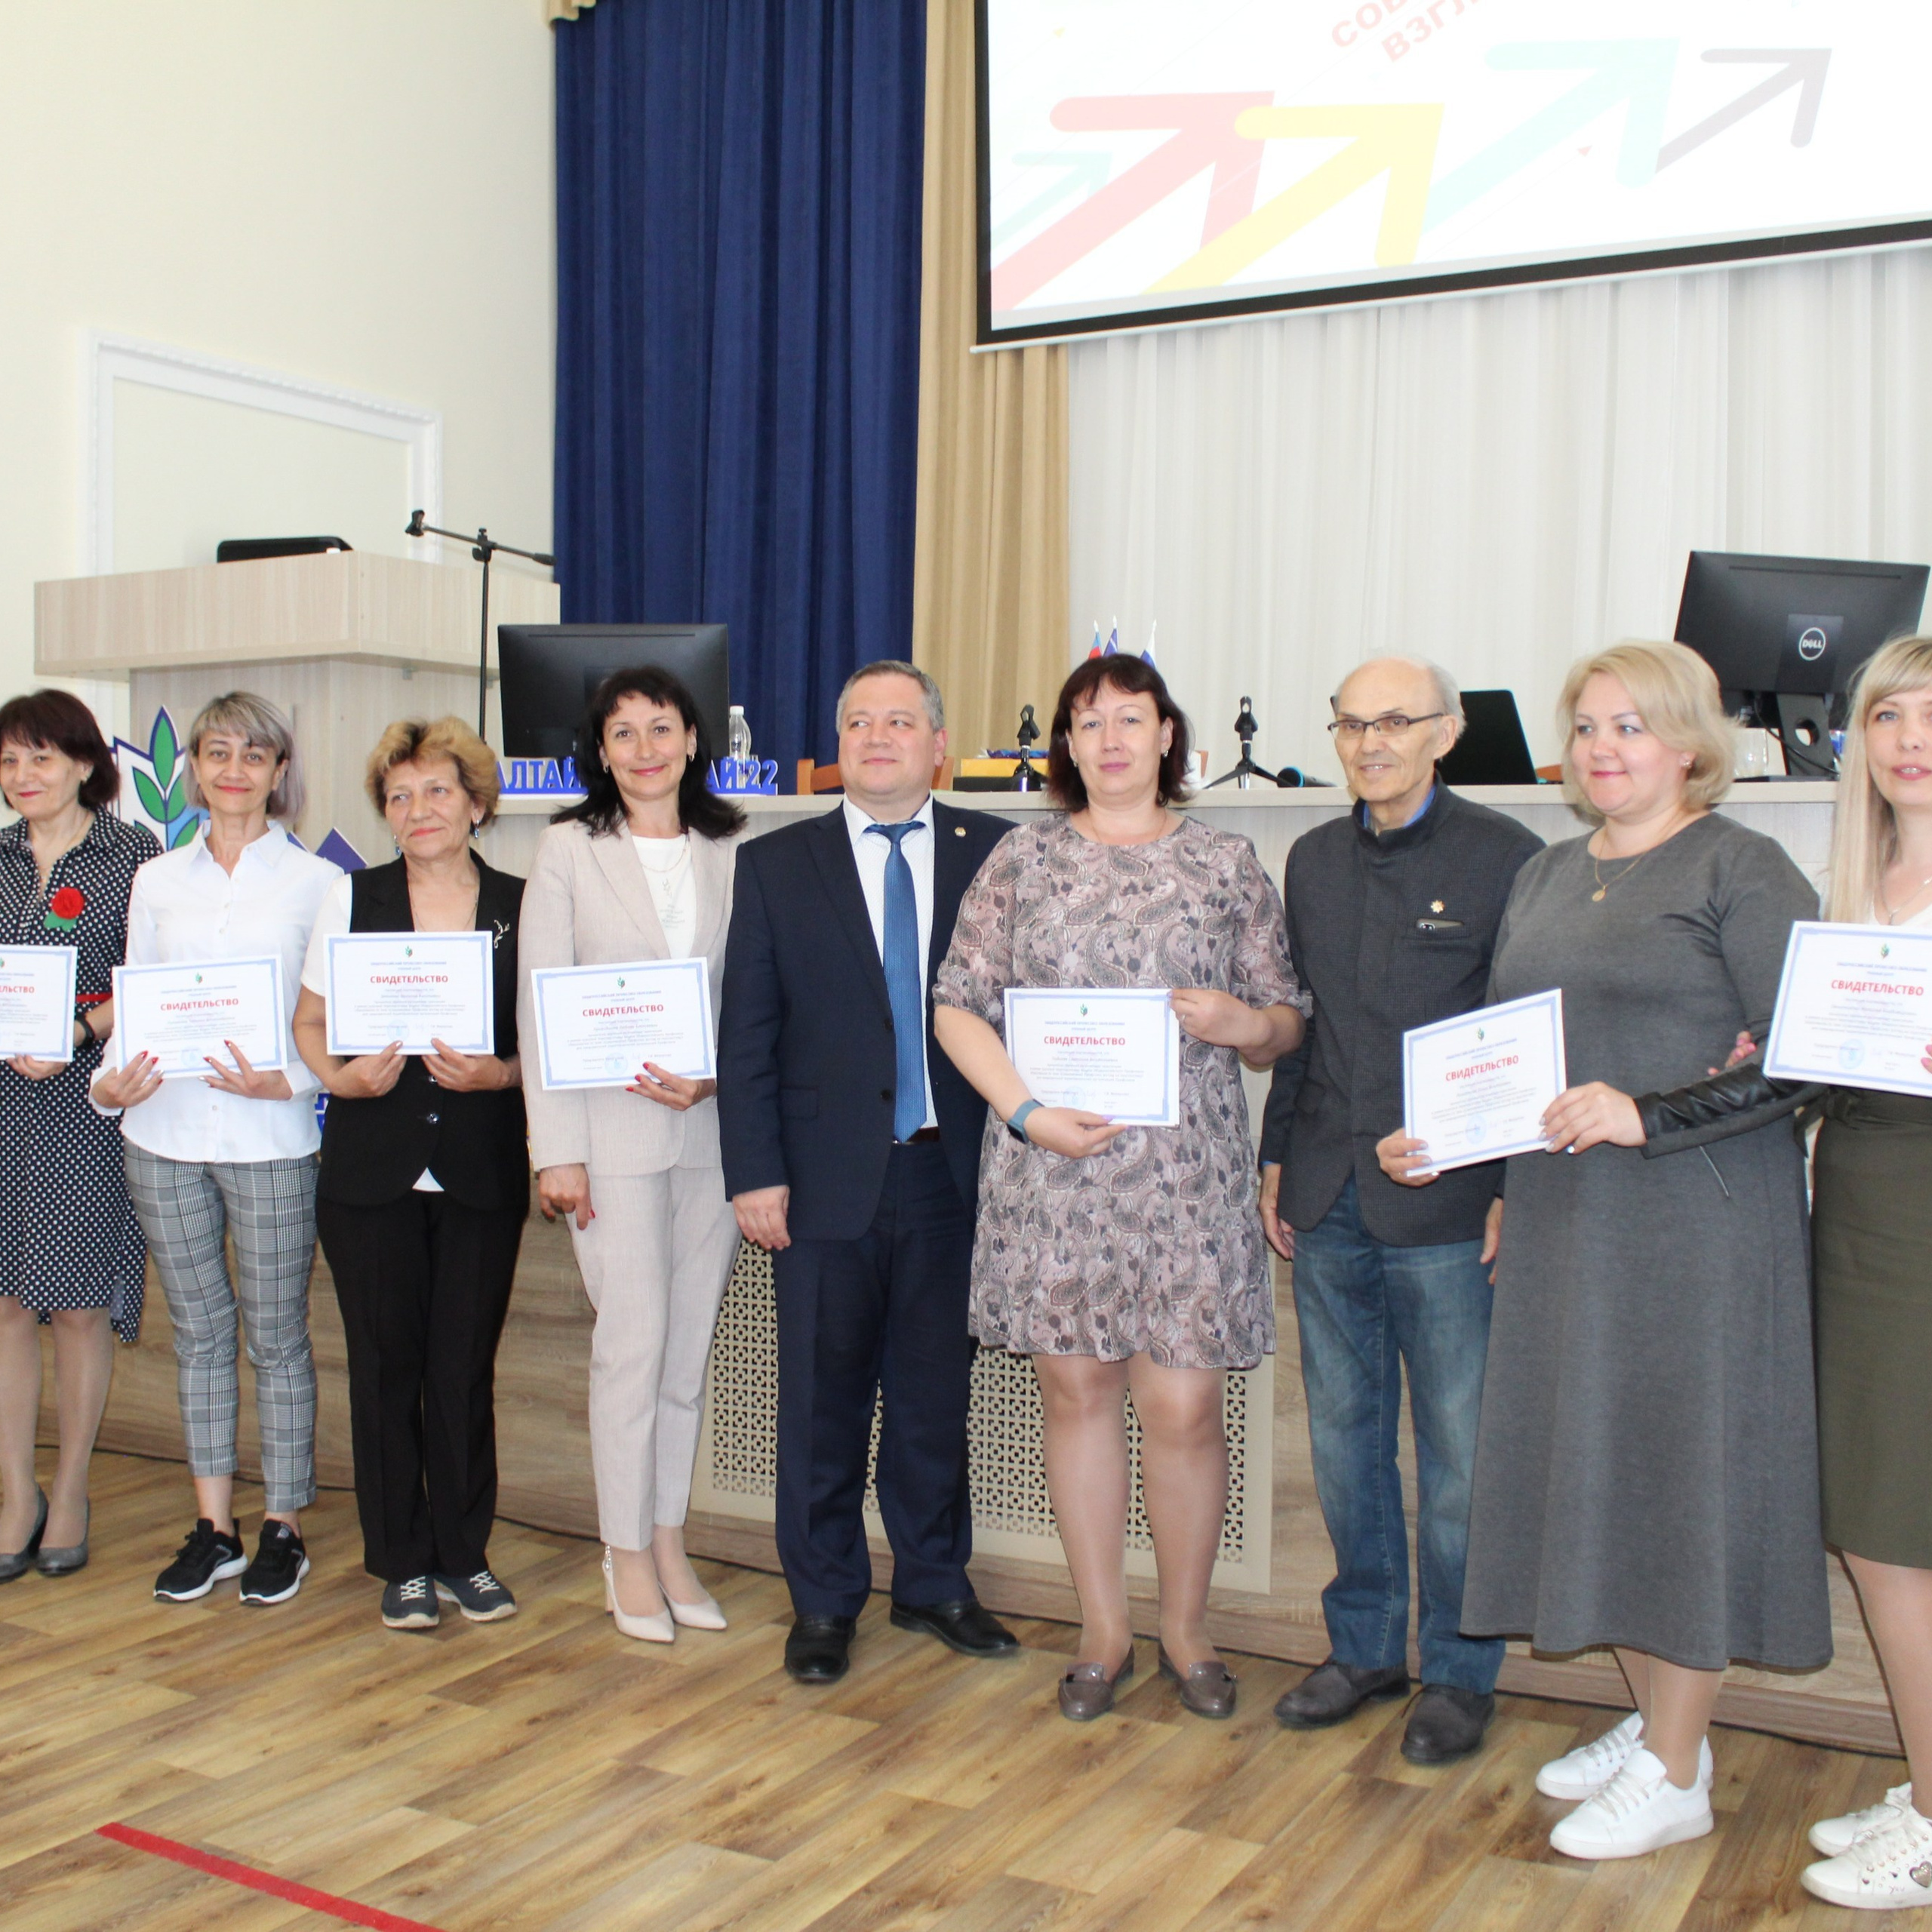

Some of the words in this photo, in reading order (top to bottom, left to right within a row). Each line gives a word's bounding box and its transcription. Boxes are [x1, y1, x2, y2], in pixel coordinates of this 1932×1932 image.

[1801, 639, 1823, 649] DELL
[370, 975, 448, 985] СВИДЕТЕЛЬСТВО
[1831, 980, 1924, 996] СВИДЕТЕЛЬСТВО
[160, 998, 239, 1011] СВИДЕТЕЛЬСТВО
[582, 1004, 664, 1017] СВИДЕТЕЛЬСТВО
[1044, 1035, 1126, 1046] СВИДЕТЕЛЬСТВО
[1445, 1054, 1519, 1081] СВИДЕТЕЛЬСТВО
